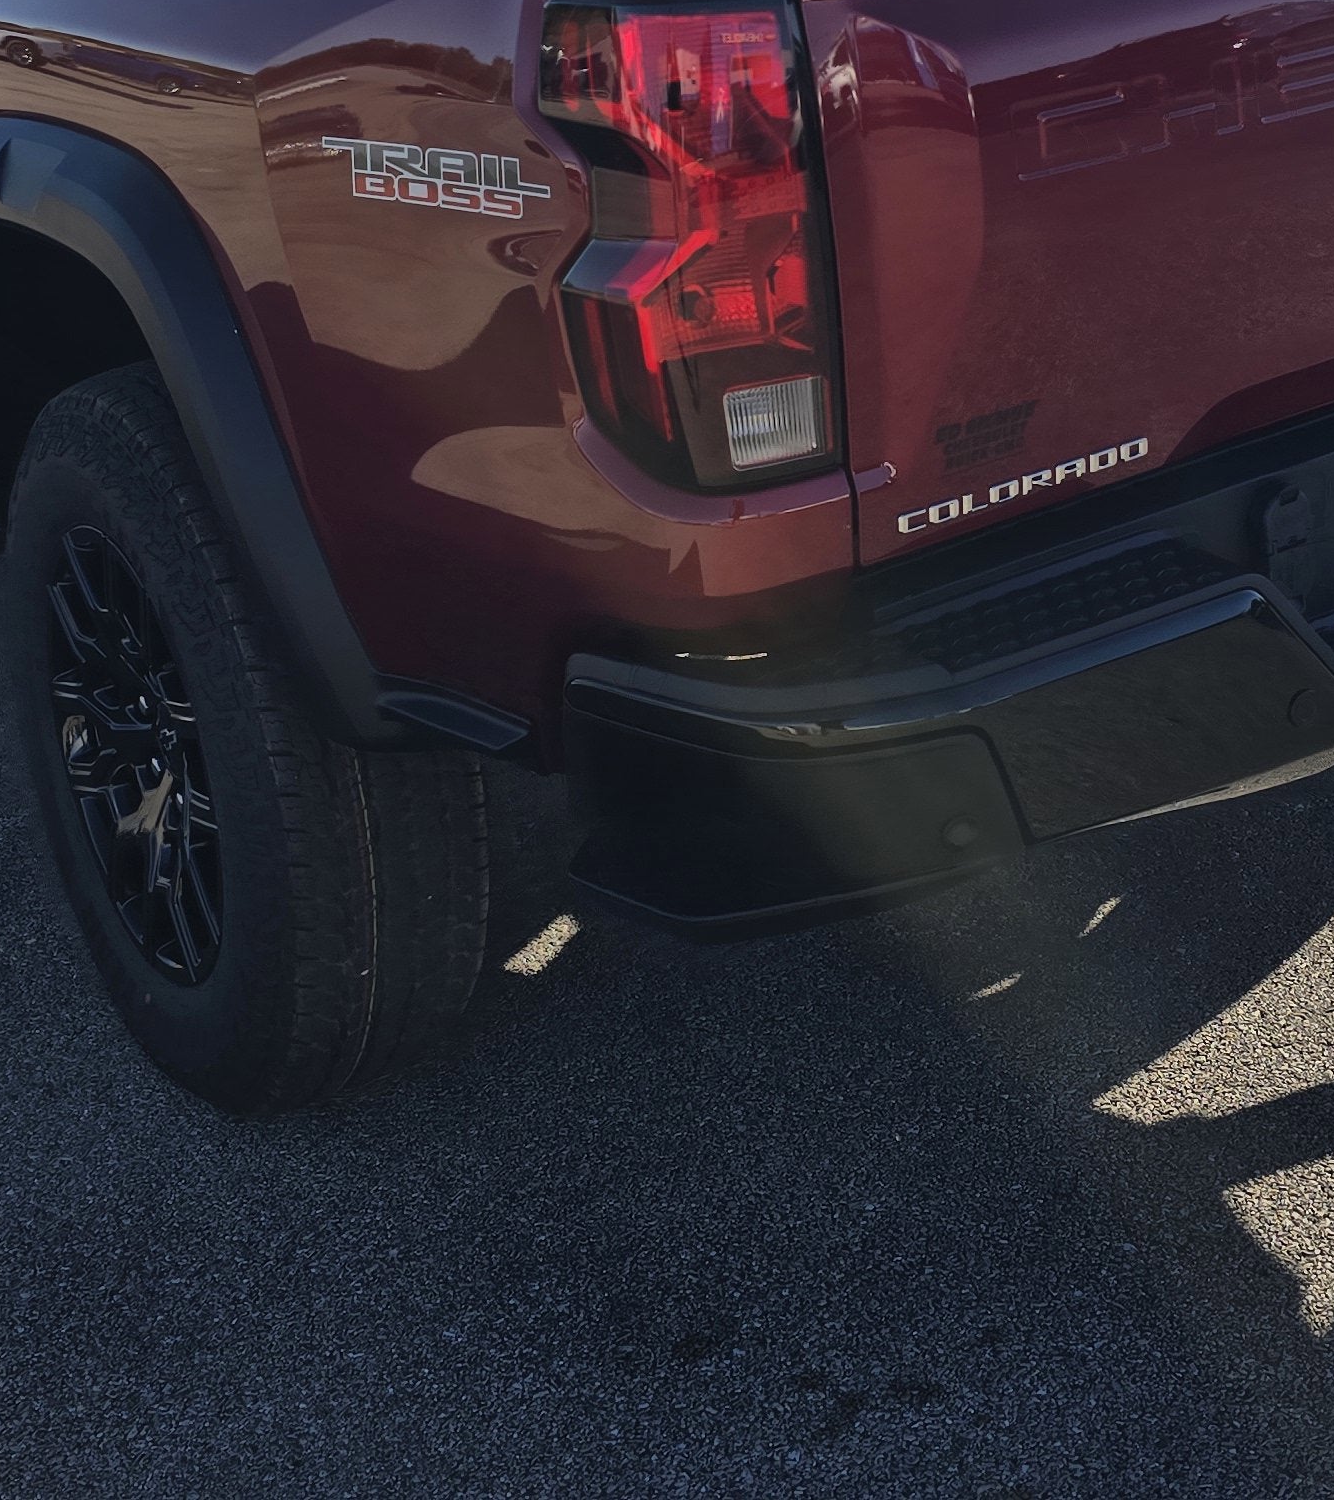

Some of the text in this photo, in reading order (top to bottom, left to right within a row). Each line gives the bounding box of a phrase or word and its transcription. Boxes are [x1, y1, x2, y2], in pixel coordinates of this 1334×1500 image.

[321, 136, 551, 199] TRAIL
[353, 170, 524, 219] BOSS
[897, 437, 1149, 535] COLORADO
